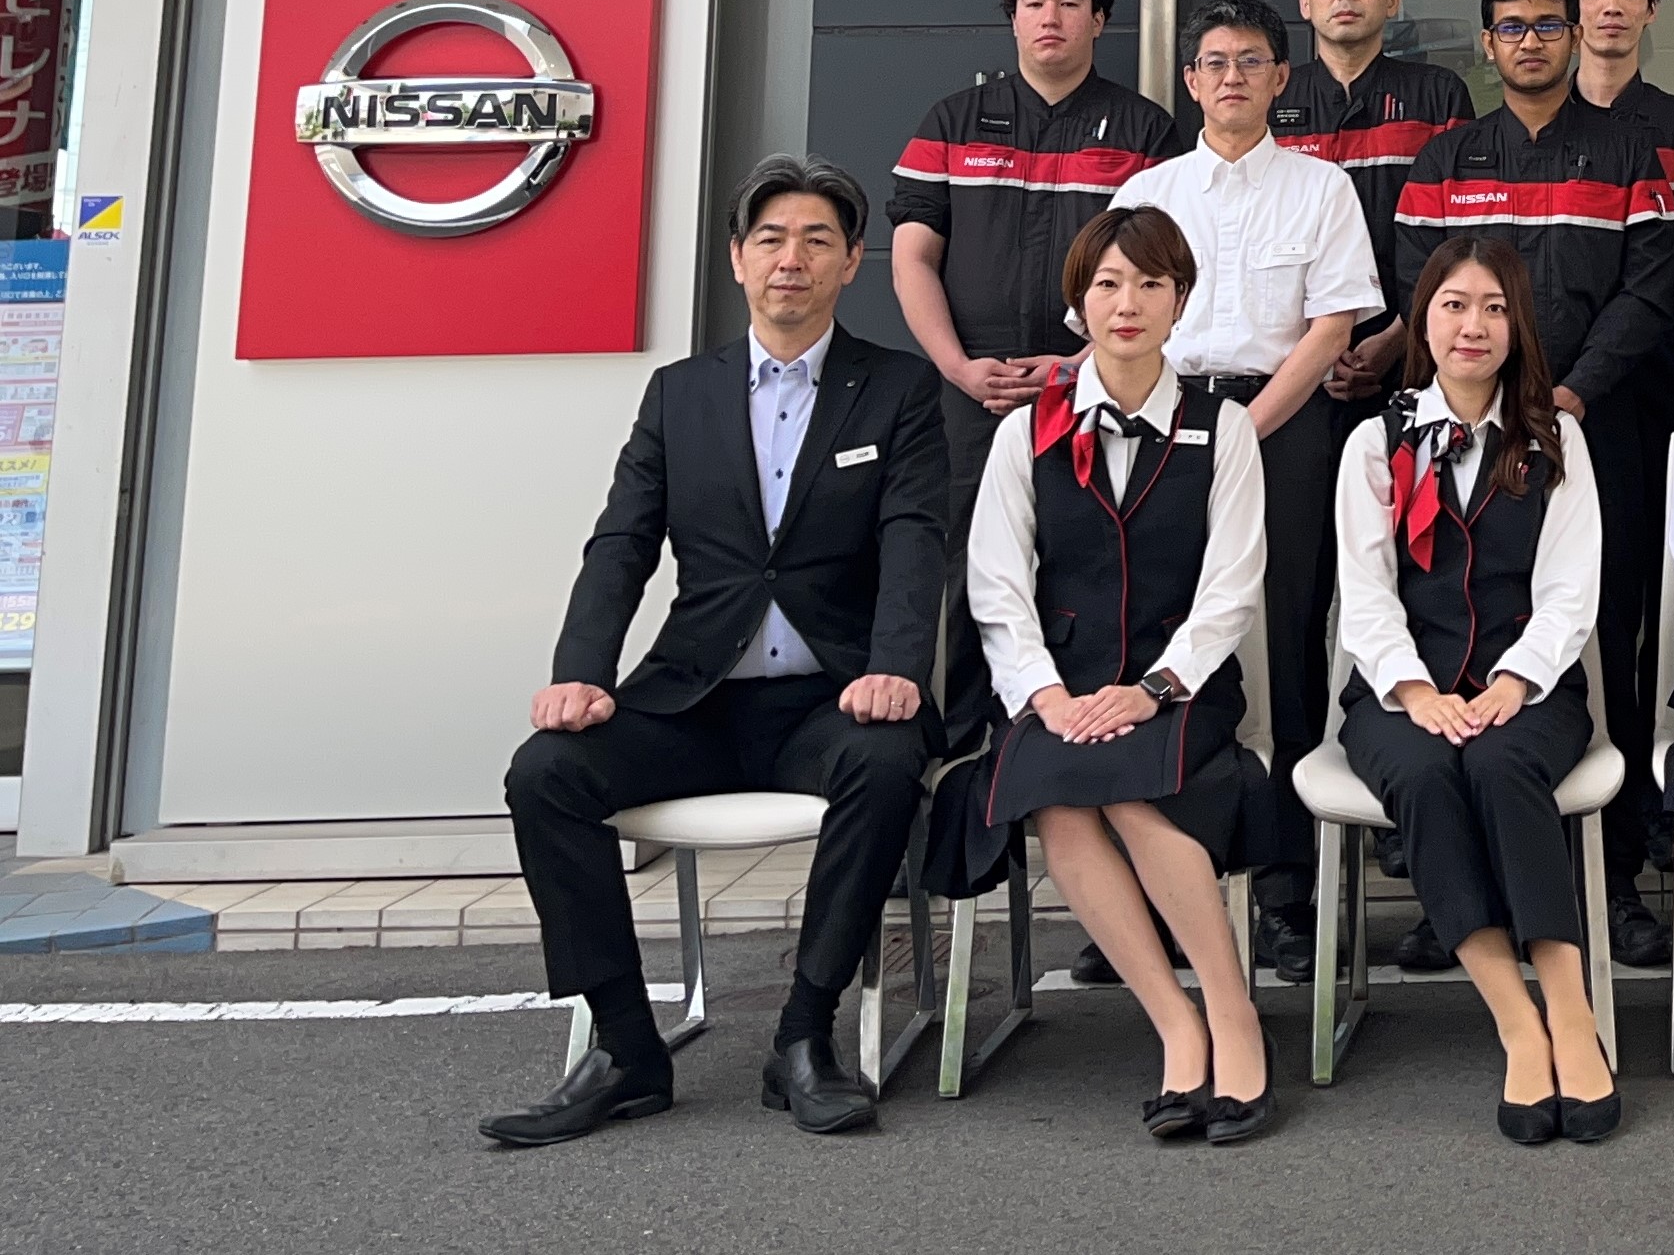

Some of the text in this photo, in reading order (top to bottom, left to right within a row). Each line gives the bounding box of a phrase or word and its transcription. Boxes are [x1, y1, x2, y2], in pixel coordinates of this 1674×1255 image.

[321, 92, 558, 130] NISSAN
[963, 156, 1015, 169] NISSAN
[1450, 192, 1508, 205] NISSAN
[78, 231, 121, 241] ALSOK
